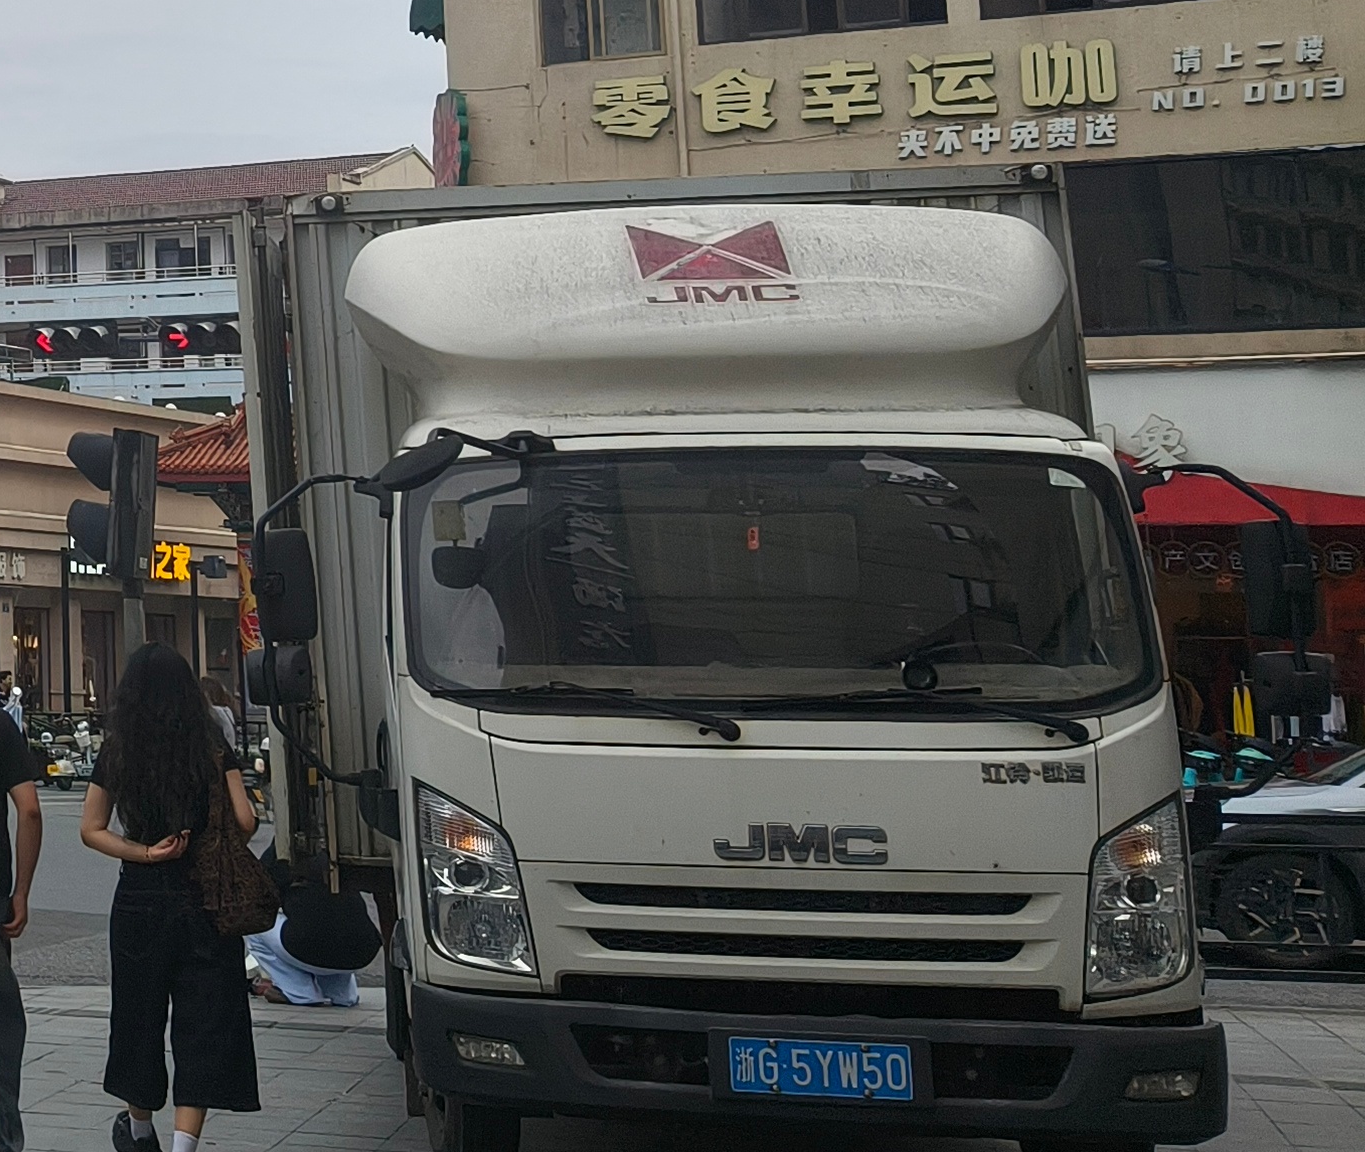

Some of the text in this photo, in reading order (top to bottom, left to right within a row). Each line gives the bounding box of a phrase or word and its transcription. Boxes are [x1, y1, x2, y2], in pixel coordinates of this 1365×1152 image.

[1171, 35, 1326, 74] 请上二楼
[591, 38, 1120, 139] 零食幸运咖
[898, 114, 1118, 160] 夹不中免费送
[645, 282, 801, 305] JMC
[714, 823, 889, 866] JMC
